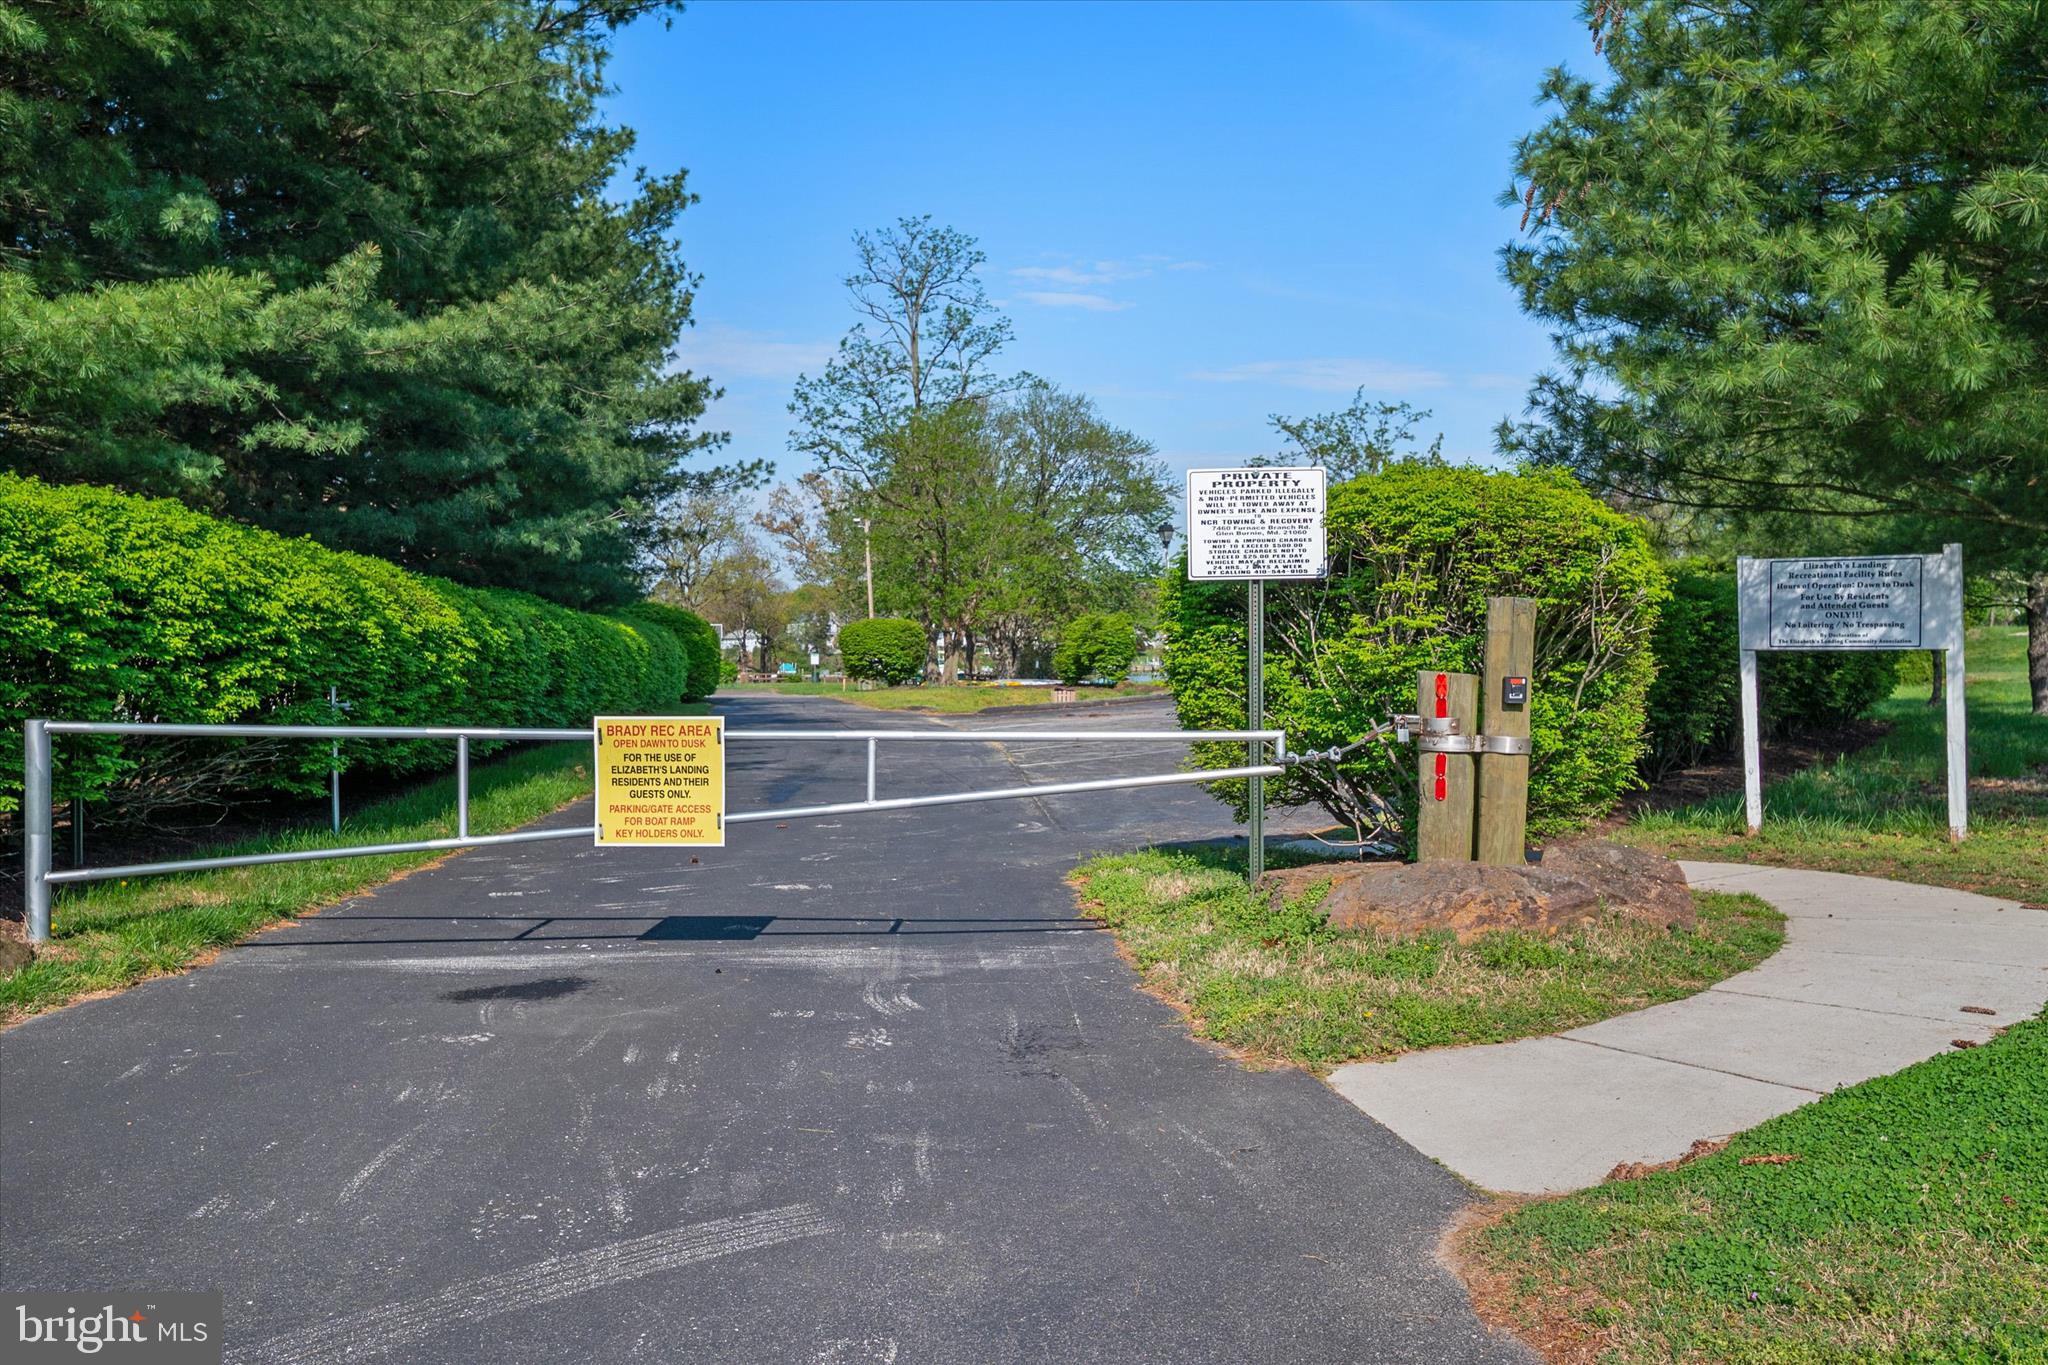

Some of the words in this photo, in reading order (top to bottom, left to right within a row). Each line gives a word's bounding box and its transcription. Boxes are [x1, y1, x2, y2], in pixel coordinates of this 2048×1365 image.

[1222, 472, 1292, 480] PRIVATE
[1844, 570, 1875, 579] Facility
[1812, 582, 1855, 590] Operation:
[1834, 593, 1844, 601] By
[1856, 621, 1904, 629] Trespassing
[607, 725, 647, 736] BRADY
[651, 725, 674, 736] REC
[679, 725, 711, 736] AREA
[613, 740, 637, 748] OPEN
[641, 740, 666, 748] DAWN
[666, 740, 678, 748] TO
[682, 740, 705, 748] DUSK
[624, 754, 641, 762] FOR
[645, 754, 661, 762] THE
[664, 754, 681, 762] USE
[684, 754, 696, 762] OF
[611, 766, 667, 774] ELIZABETH'S
[670, 766, 709, 774] LANDING
[612, 778, 660, 786] RESIDENTS
[664, 778, 683, 786] AND
[684, 778, 709, 786] THEIR
[630, 790, 664, 798] GUESTS
[668, 790, 691, 798] ONLY.
[609, 805, 673, 813] PARKING/GATE
[676, 805, 711, 813] ACCESS
[625, 817, 642, 825] FOR
[645, 817, 667, 825] BOAT
[671, 817, 695, 825] RAMP
[616, 829, 633, 838] KEY
[636, 829, 677, 838] HOLDERS
[680, 829, 704, 838] ONLY.
